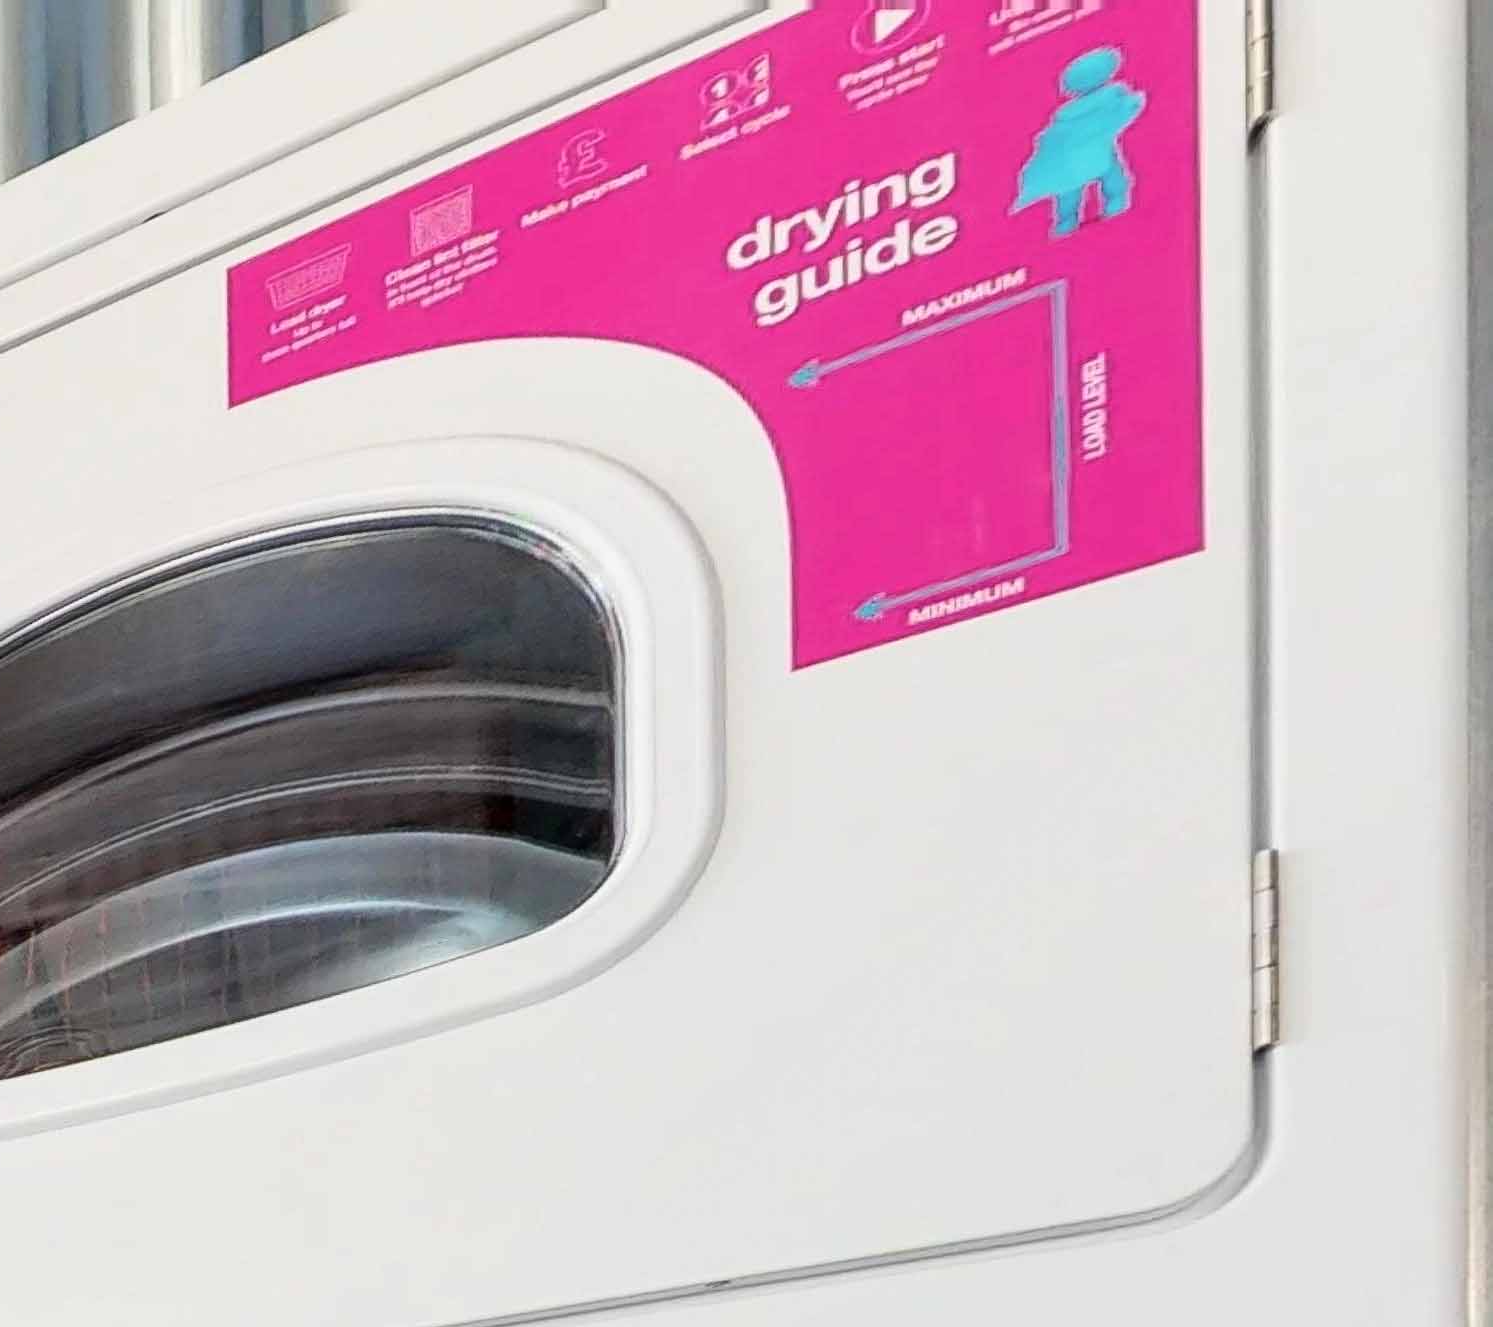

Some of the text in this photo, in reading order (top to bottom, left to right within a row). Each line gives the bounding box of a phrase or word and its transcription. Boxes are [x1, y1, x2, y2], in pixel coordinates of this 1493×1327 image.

[725, 151, 956, 270] drying
[753, 215, 959, 327] guide
[901, 267, 1027, 326] MAXIMUM
[1081, 352, 1107, 461] LOAD LEVEL
[907, 577, 1025, 624] MINIMUM
